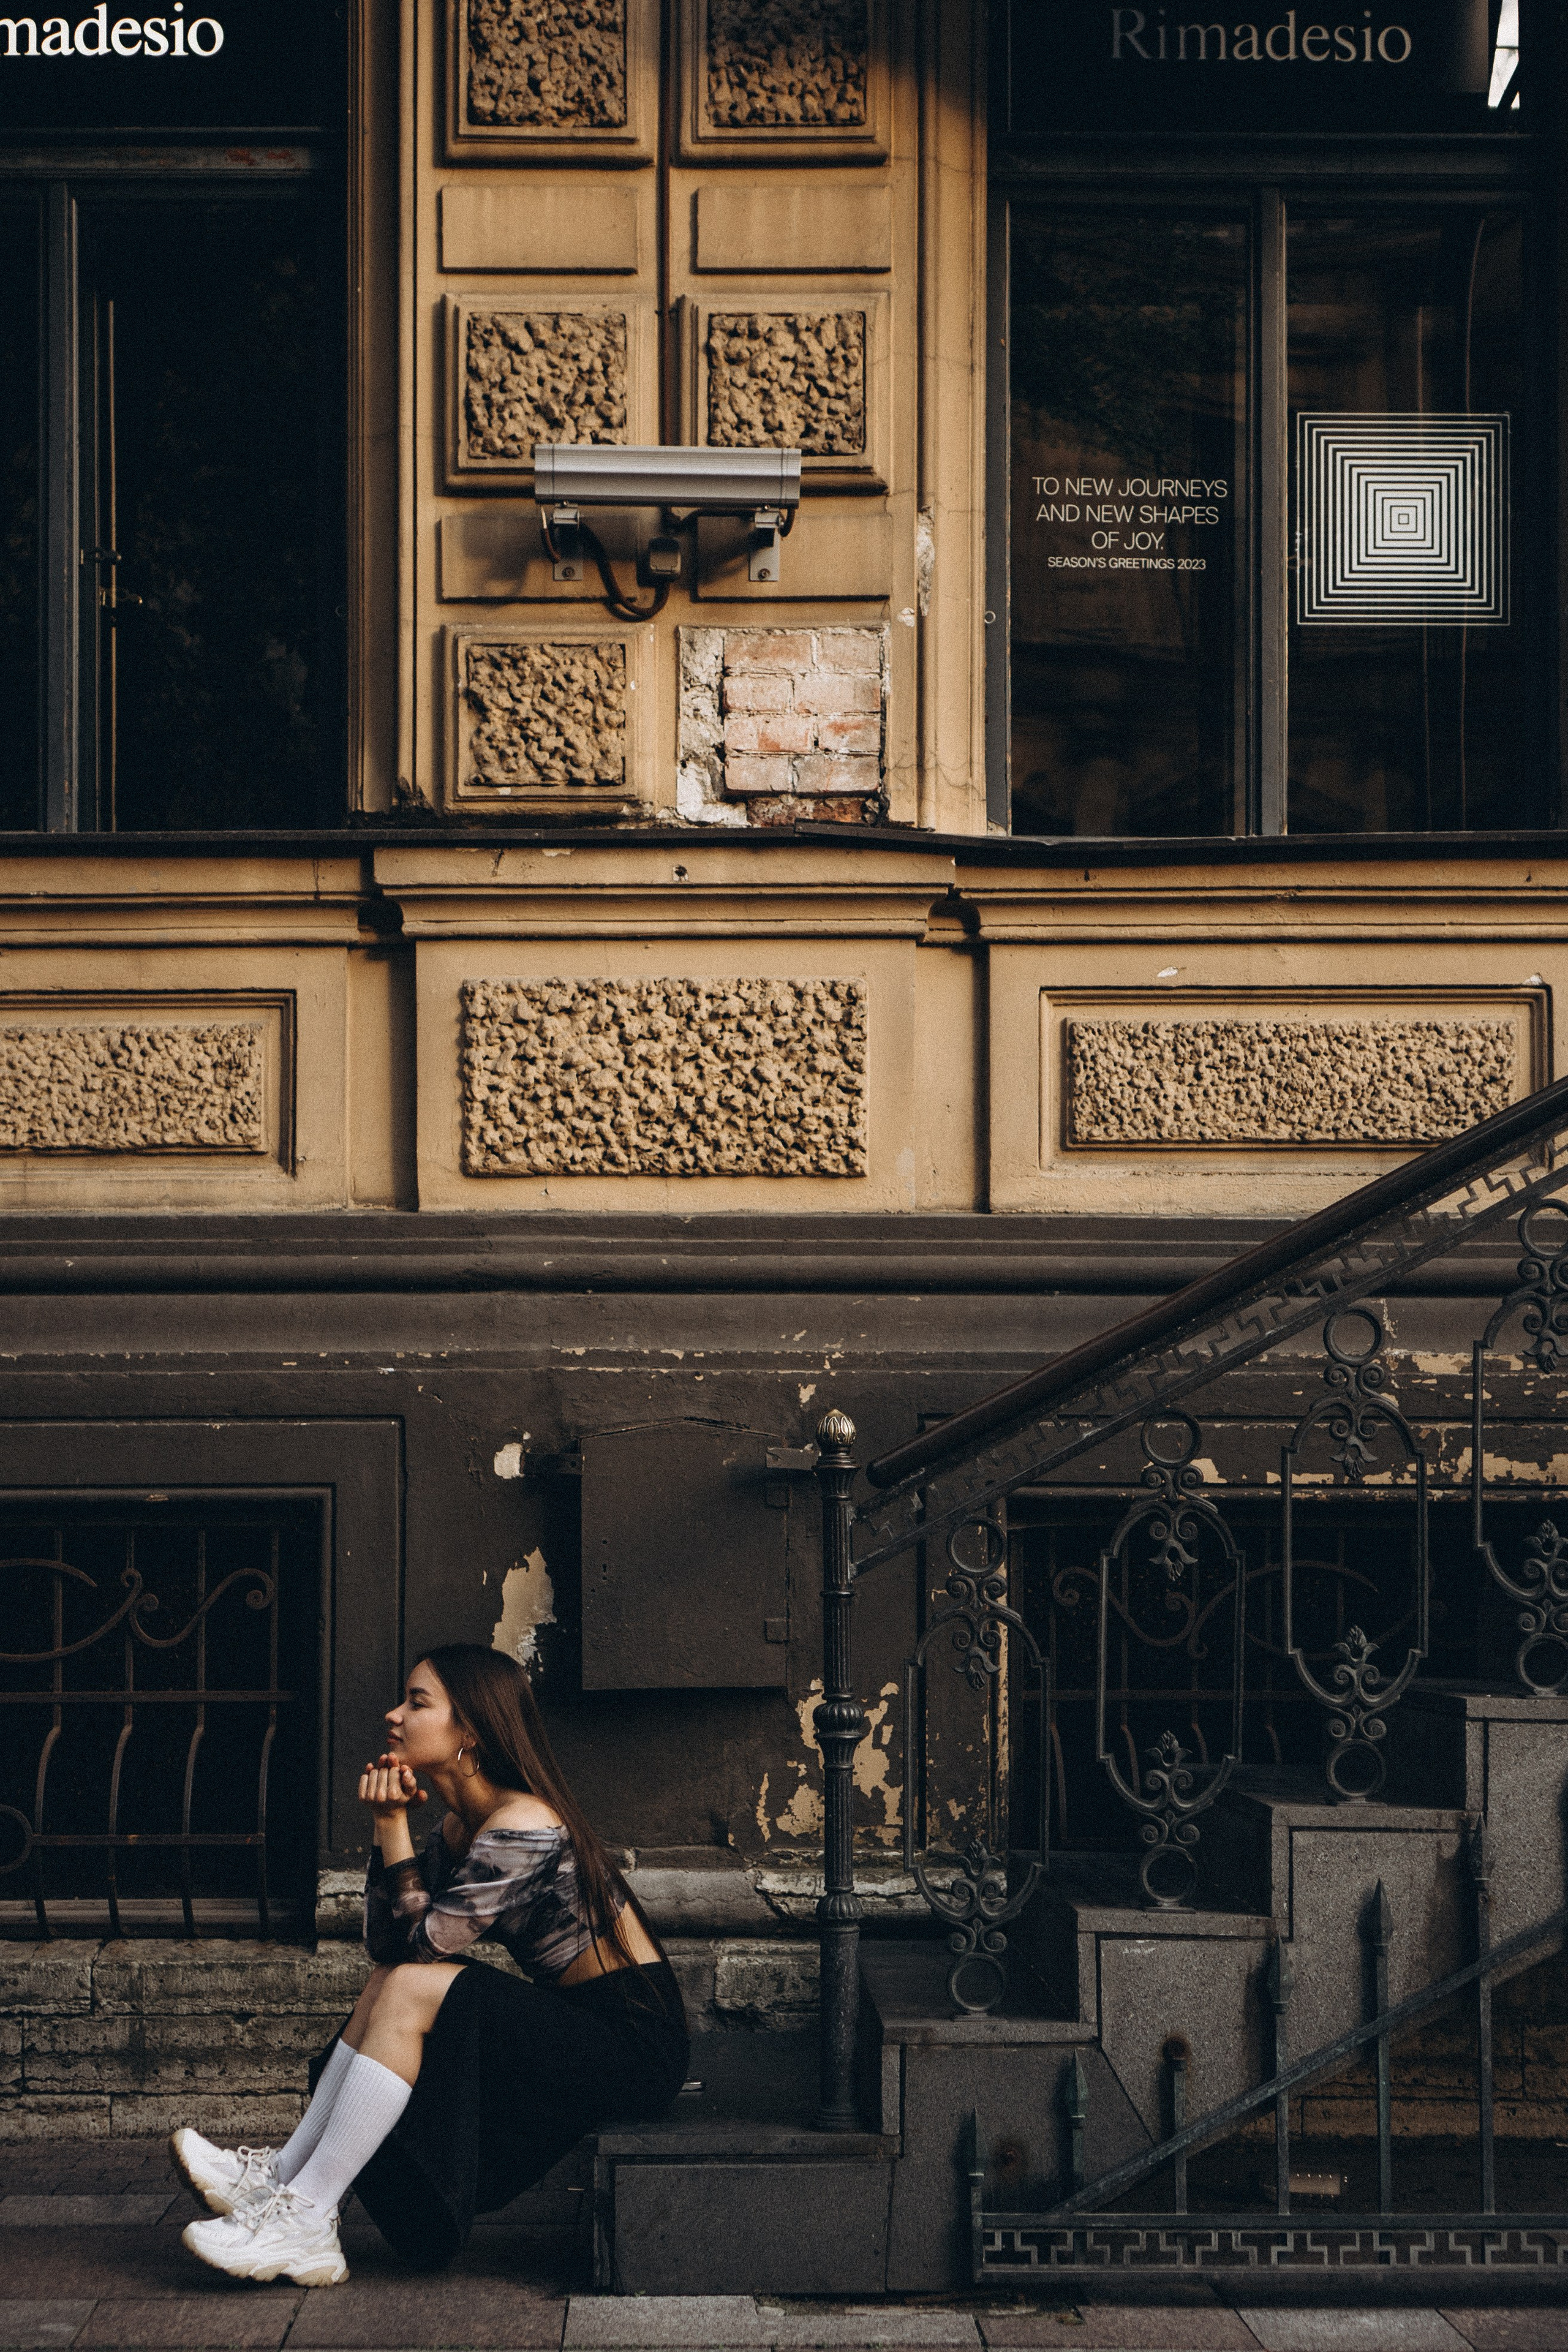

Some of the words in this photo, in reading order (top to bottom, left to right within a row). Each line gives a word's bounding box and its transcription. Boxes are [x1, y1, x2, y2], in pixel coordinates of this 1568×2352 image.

[1110, 8, 1412, 63] Rimadesio
[1032, 477, 1060, 496] TO
[1065, 478, 1114, 496] NEW
[1118, 478, 1228, 498] JOURNEYS
[1036, 504, 1080, 522] AND
[1086, 505, 1134, 523] NEW
[1139, 505, 1219, 524] SHAPES
[1091, 531, 1120, 549] OF
[1123, 531, 1164, 550] JOY.
[1047, 556, 1106, 568] SEASON'S
[1109, 557, 1175, 570] GREETINGS
[1177, 559, 1207, 570] 2023
